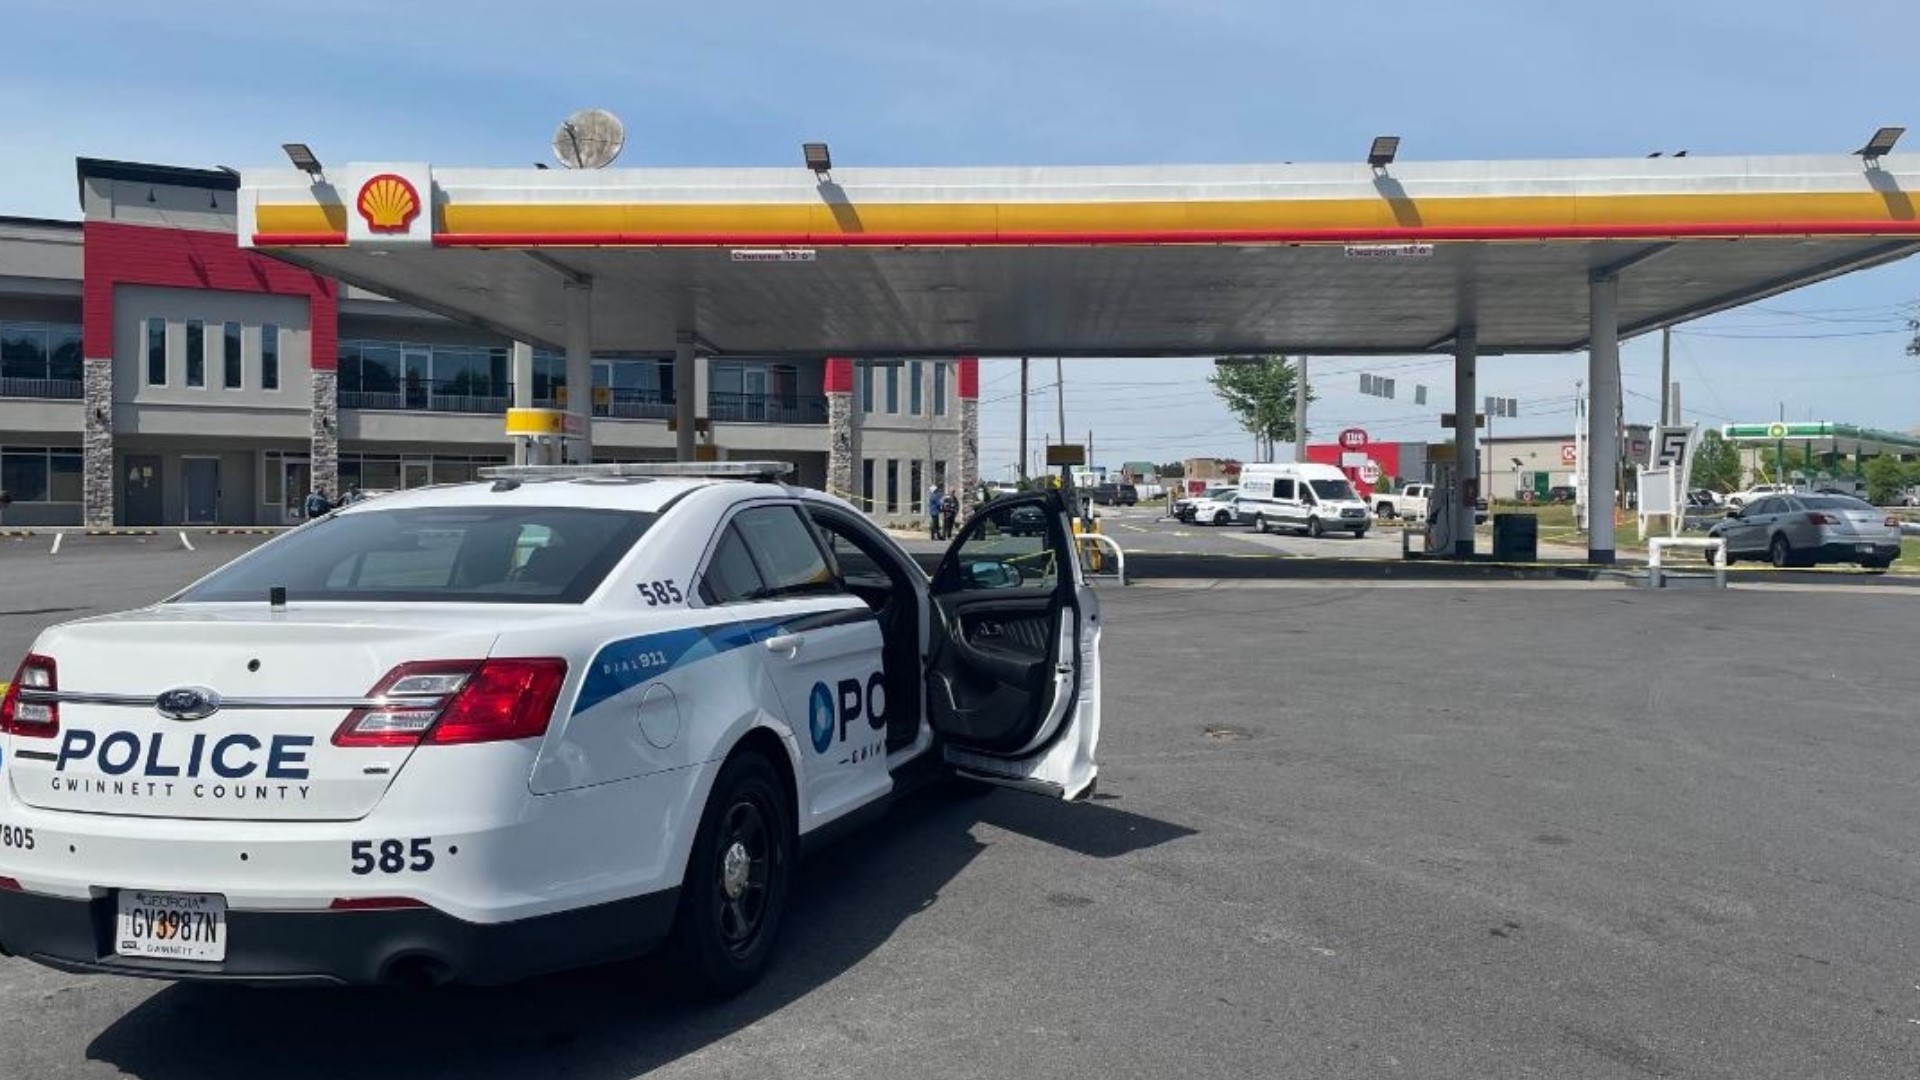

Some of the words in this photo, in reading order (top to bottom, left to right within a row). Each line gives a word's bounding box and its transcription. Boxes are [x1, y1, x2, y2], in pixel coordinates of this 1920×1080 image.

[1346, 432, 1364, 441] Tire
[637, 579, 683, 606] 585
[603, 660, 639, 675] DIAL
[639, 651, 667, 668] 911
[56, 729, 315, 780] POLICE
[51, 777, 175, 797] GWINNETT
[194, 784, 310, 800] COUNTY
[351, 837, 435, 875] 585
[142, 895, 200, 909] GEORGIA
[132, 908, 216, 943] GV3987N
